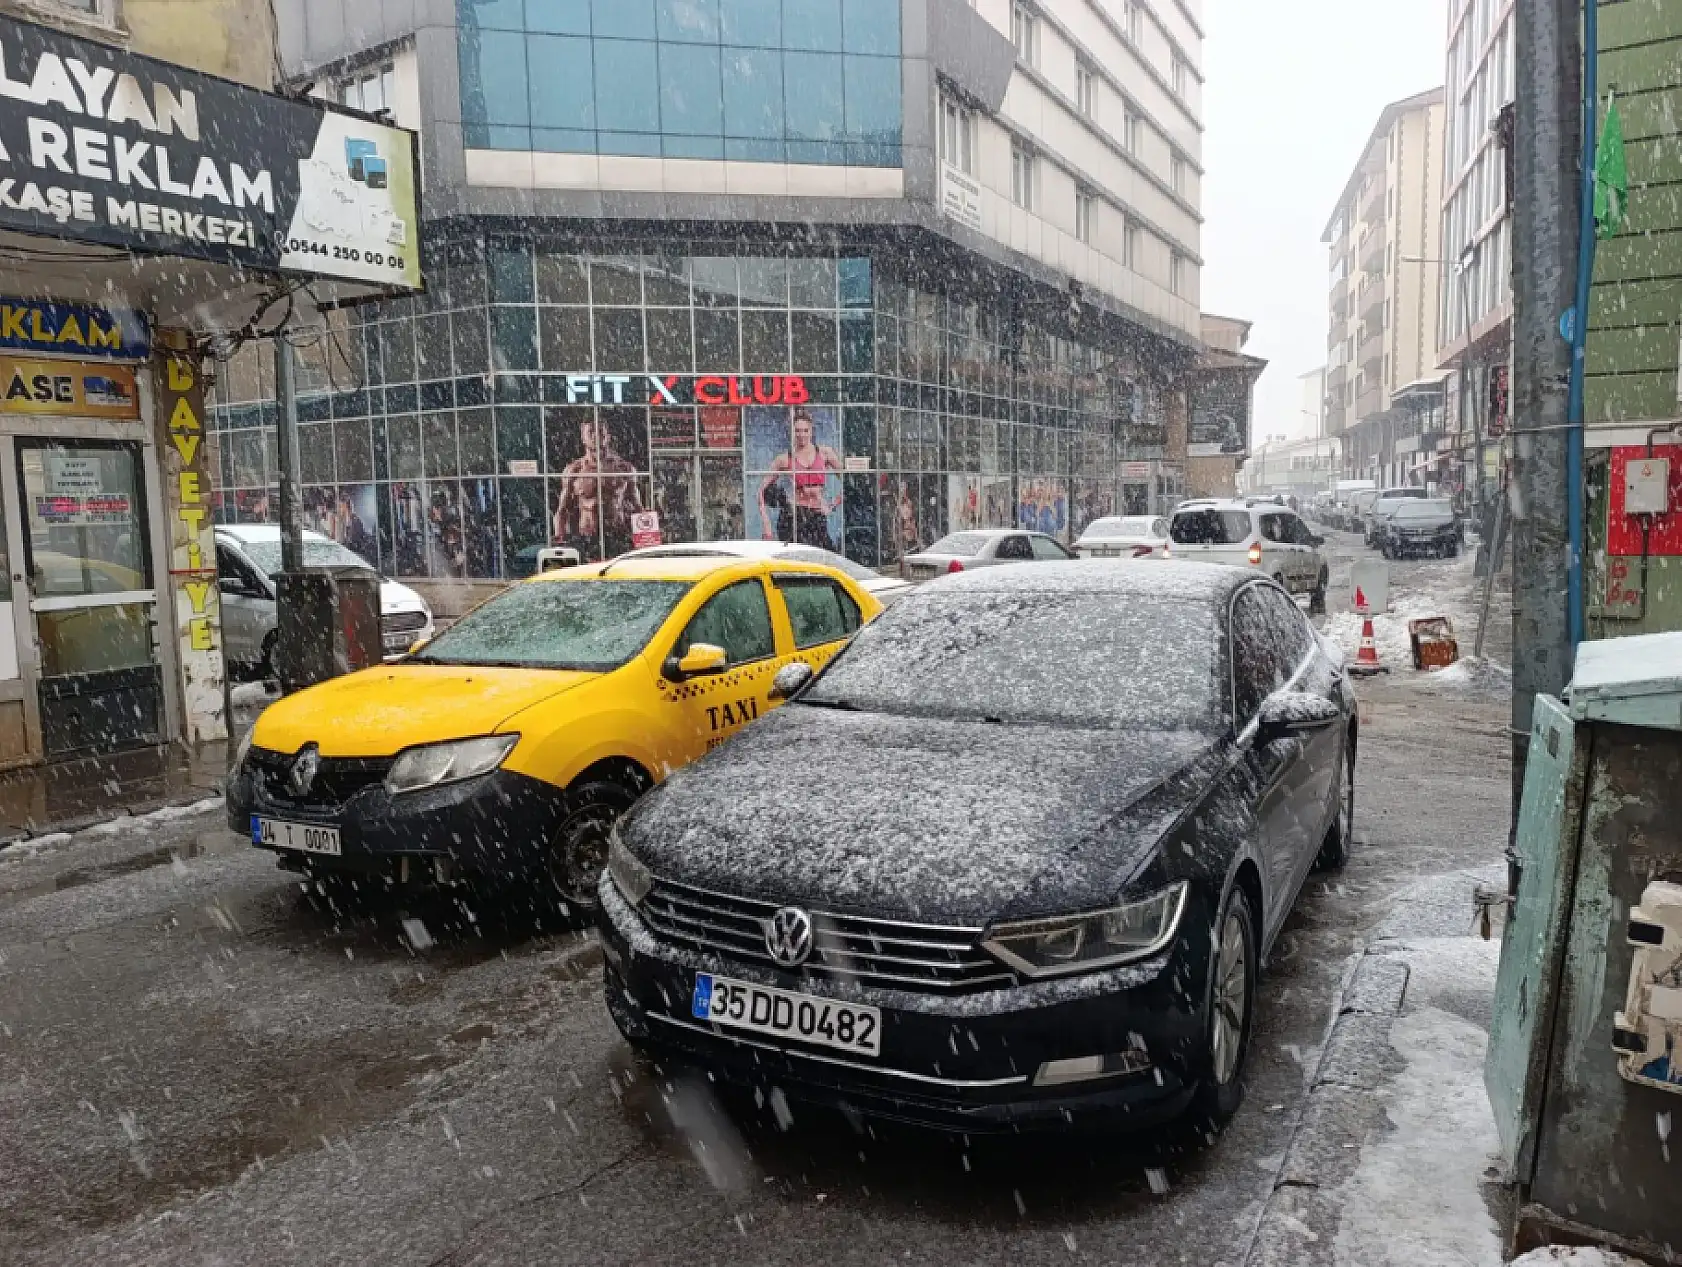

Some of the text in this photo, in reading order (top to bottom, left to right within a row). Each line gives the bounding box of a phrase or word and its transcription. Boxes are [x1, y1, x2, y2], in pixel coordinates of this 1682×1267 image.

[27, 115, 275, 213] REKLAM
[0, 178, 255, 248] KAŞE MERKEZİ
[290, 238, 328, 257] 0544
[333, 245, 360, 262] 250
[364, 251, 383, 267] 00
[649, 374, 678, 405] X
[694, 375, 809, 405] CLUB
[260, 821, 275, 842] 04
[284, 824, 293, 845] T
